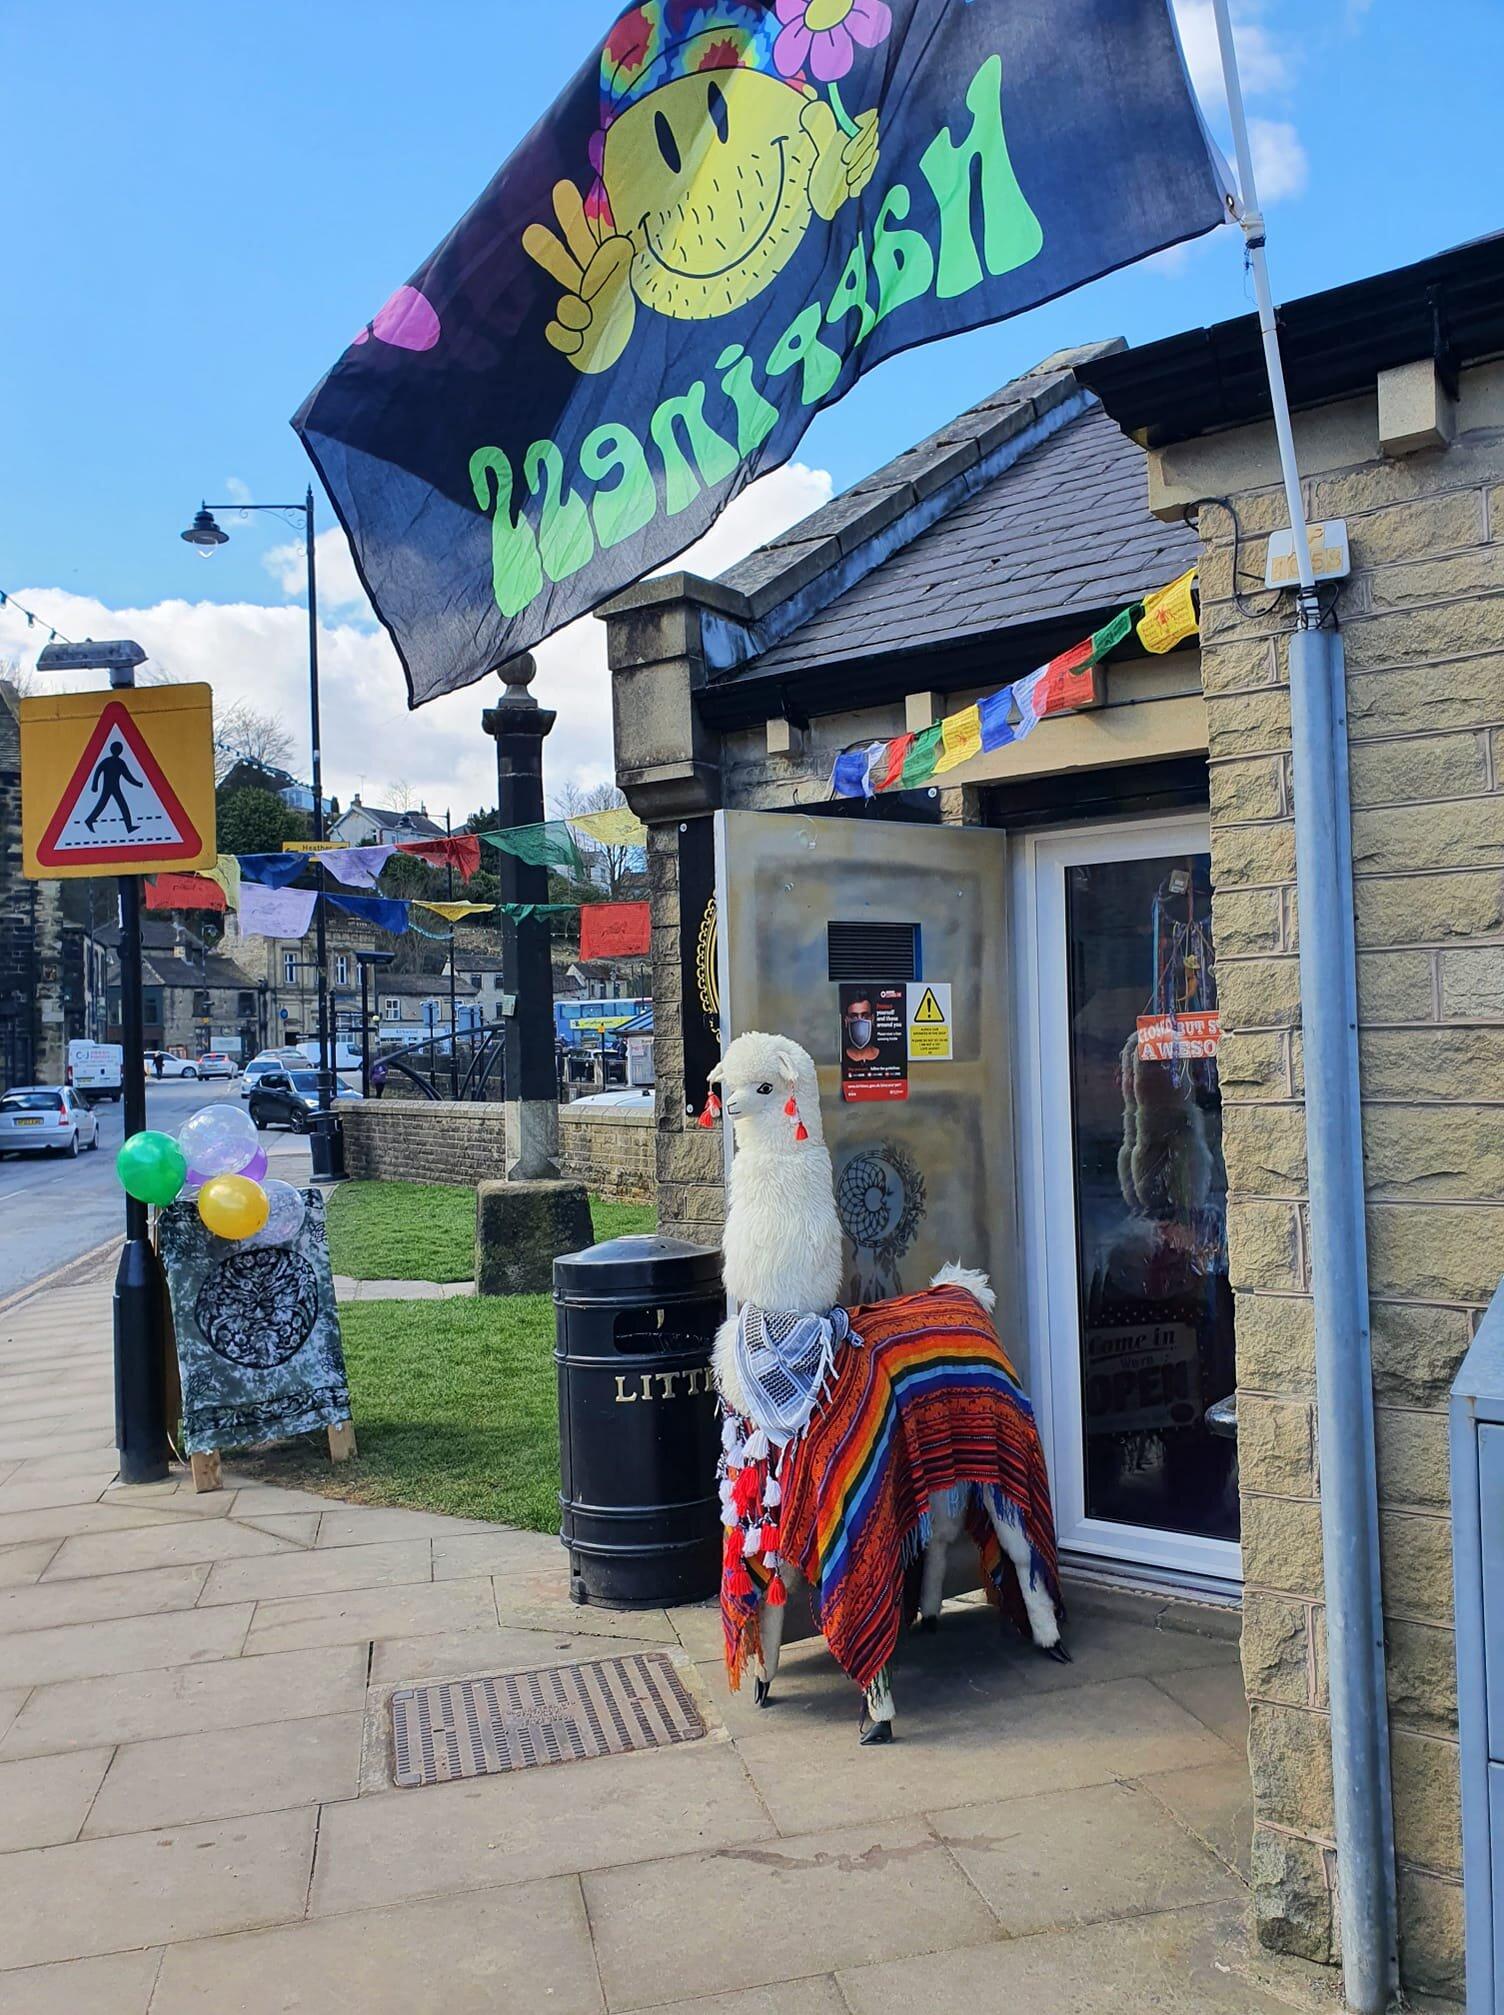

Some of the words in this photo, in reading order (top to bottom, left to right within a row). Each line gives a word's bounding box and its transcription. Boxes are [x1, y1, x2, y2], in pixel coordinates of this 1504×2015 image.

[1177, 1020, 1205, 1037] BUT
[1089, 1333, 1147, 1356] Come
[1153, 1327, 1175, 1346] in
